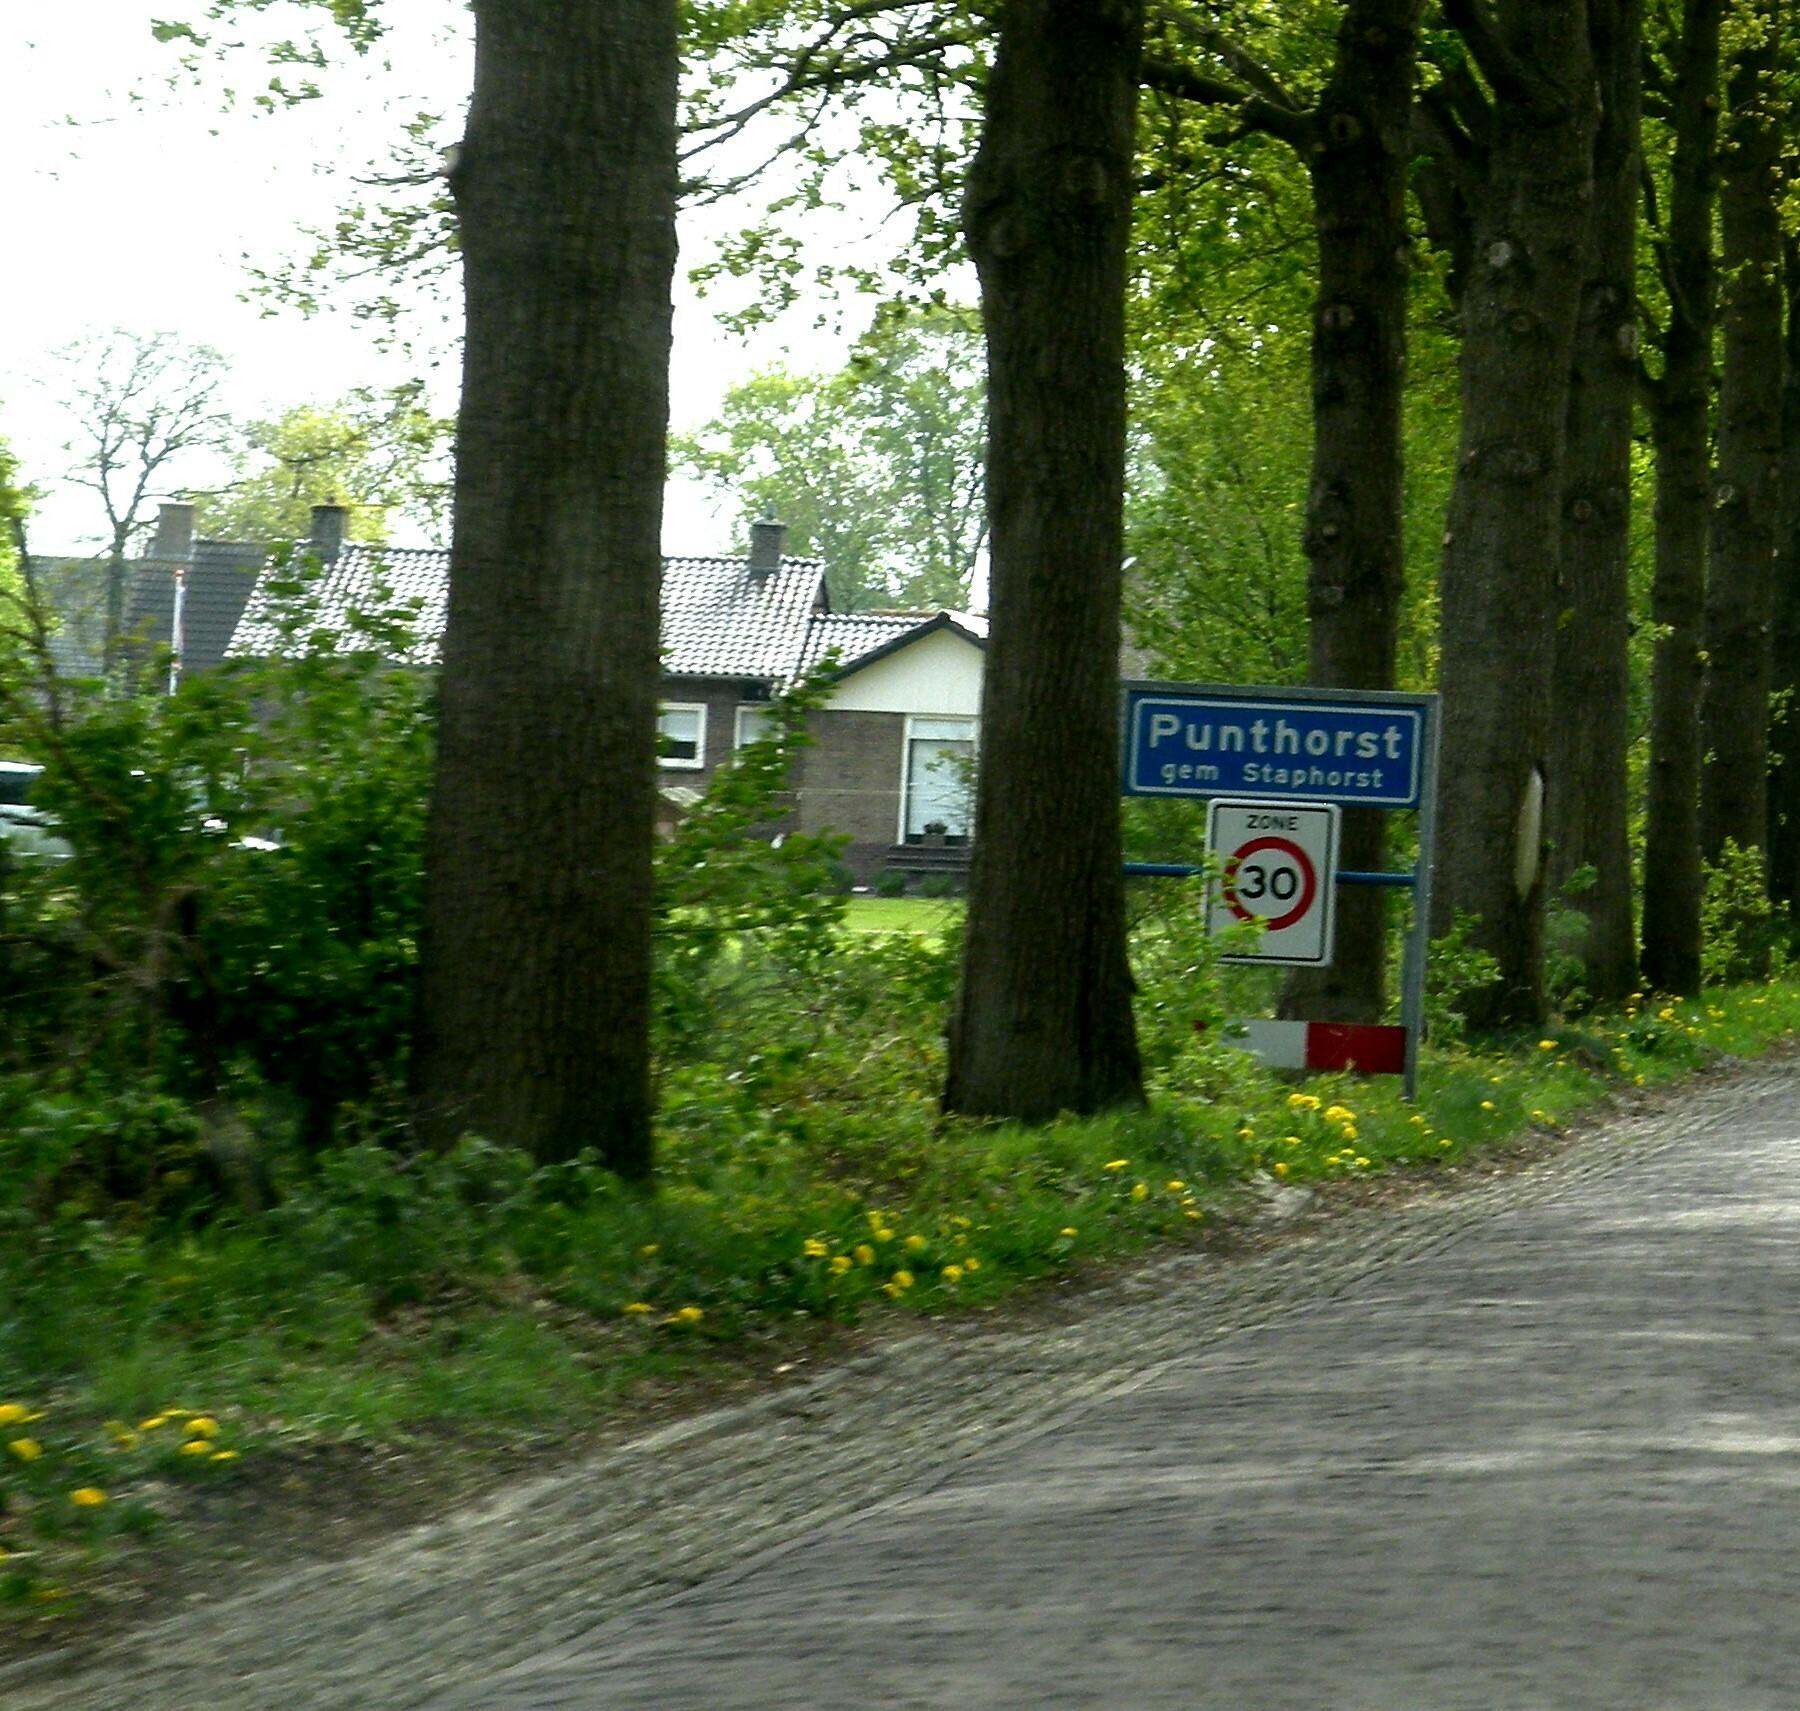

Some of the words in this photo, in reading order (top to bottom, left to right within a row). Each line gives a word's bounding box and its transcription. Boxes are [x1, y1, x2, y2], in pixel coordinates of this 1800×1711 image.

[1149, 713, 1402, 759] Punthorst
[1160, 762, 1219, 784] gem
[1242, 762, 1384, 789] Staphorst
[1246, 814, 1299, 831] ZONE
[1239, 865, 1297, 901] 30
